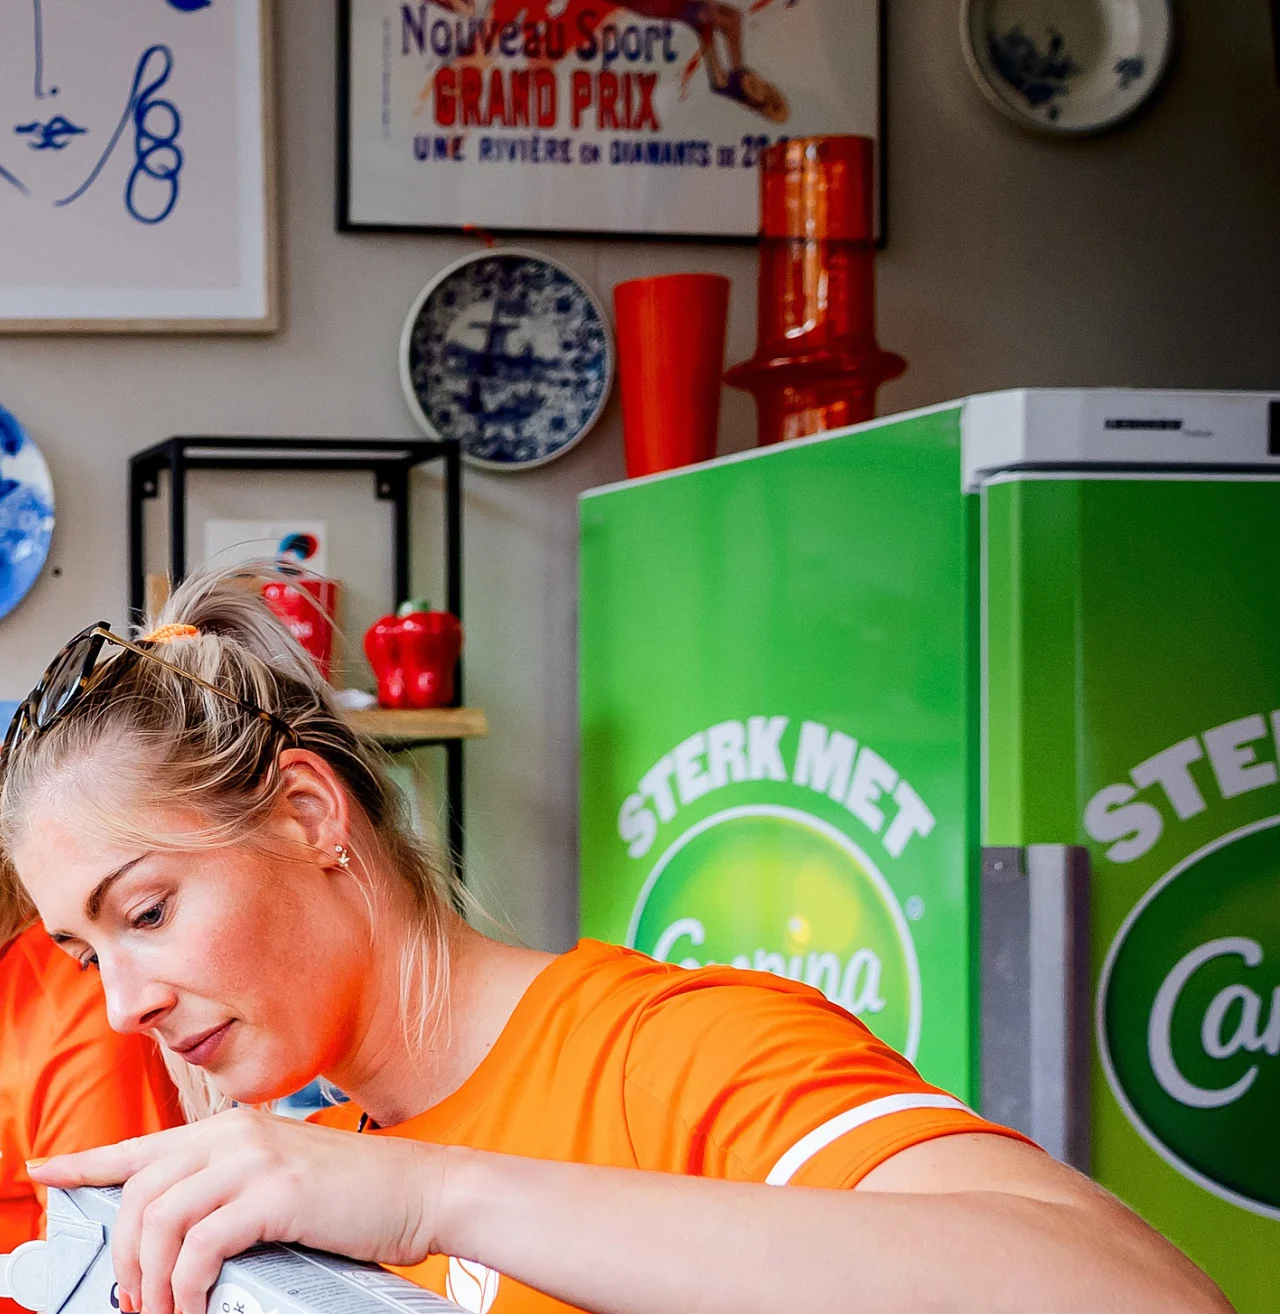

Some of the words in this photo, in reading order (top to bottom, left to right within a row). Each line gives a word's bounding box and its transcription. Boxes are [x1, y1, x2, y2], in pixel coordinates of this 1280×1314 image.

[402, 3, 565, 60] Nouveau
[576, 10, 678, 70] Sport
[434, 66, 556, 129] GRAND
[571, 69, 661, 132] PRIX
[413, 134, 465, 163] UNE
[618, 716, 790, 860] STERK
[793, 720, 936, 860] MET
[1083, 708, 1280, 864] STE
